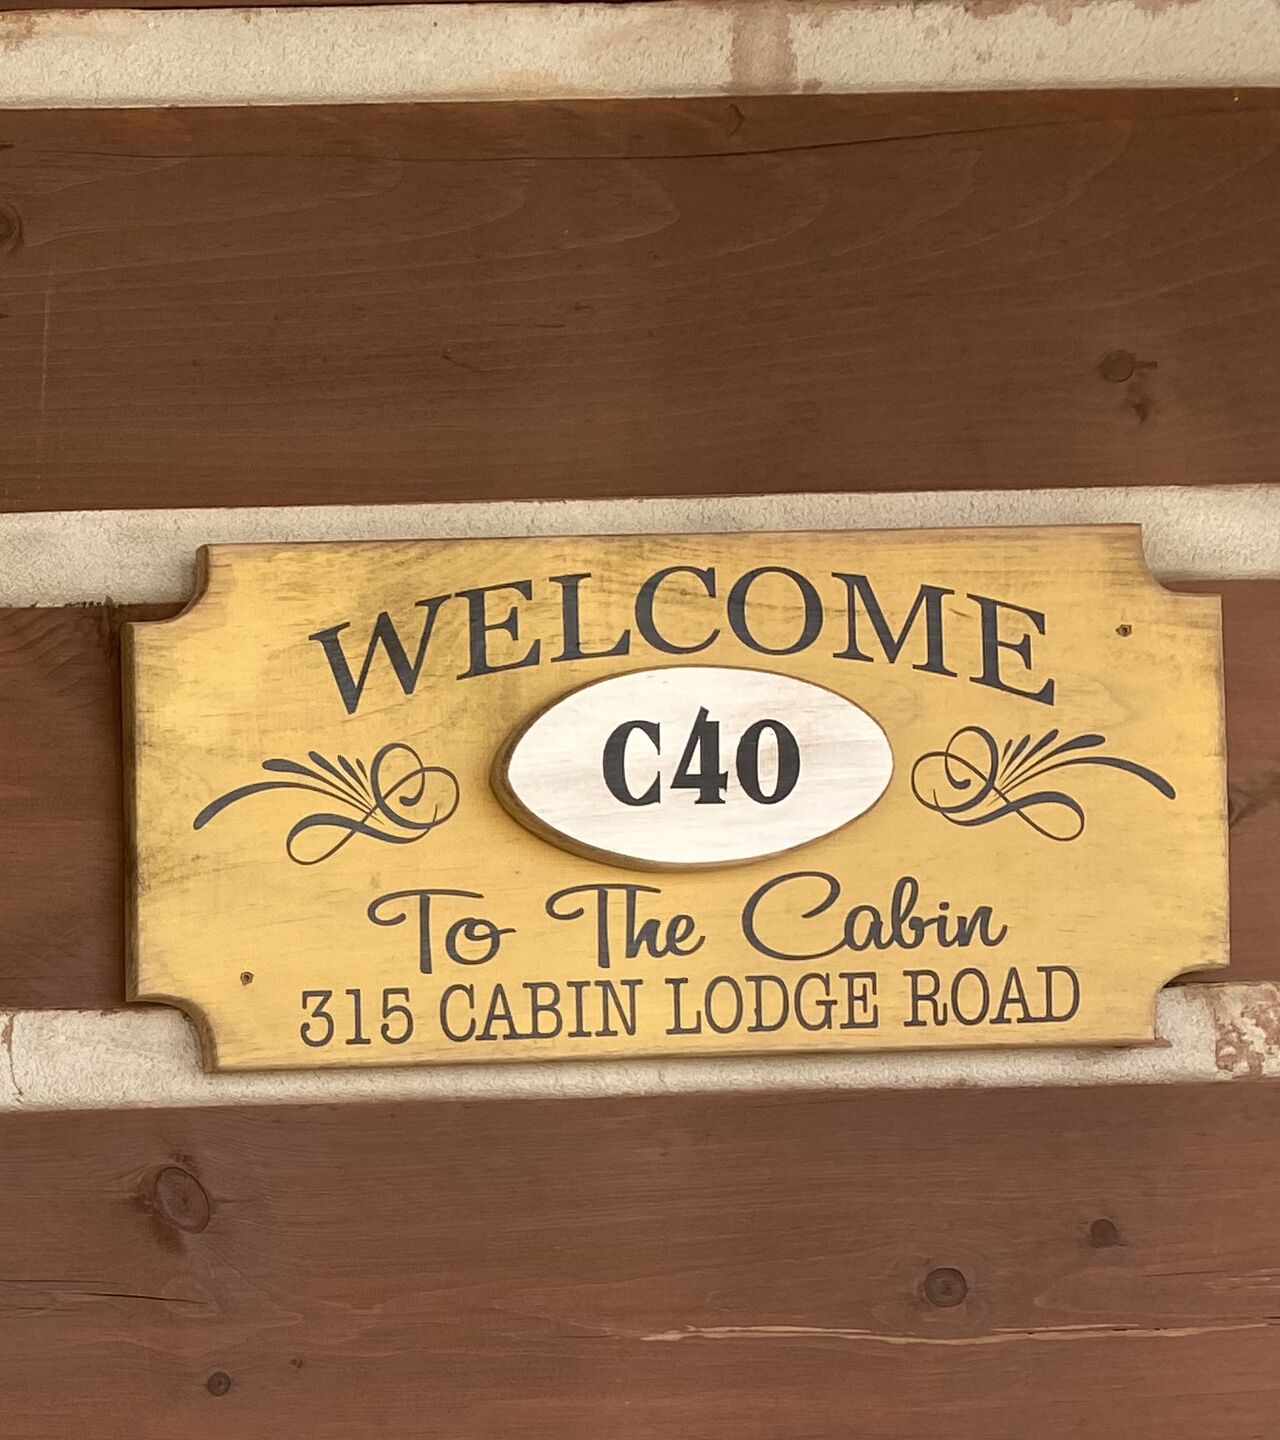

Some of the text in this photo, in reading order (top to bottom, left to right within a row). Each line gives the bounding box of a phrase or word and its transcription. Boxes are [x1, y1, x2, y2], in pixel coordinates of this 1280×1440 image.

[309, 565, 1055, 715] WELCOME
[602, 706, 801, 807] C40
[367, 871, 1008, 975] To The Cabin
[300, 965, 1080, 1047] 315 CABIN LODGE ROAD
